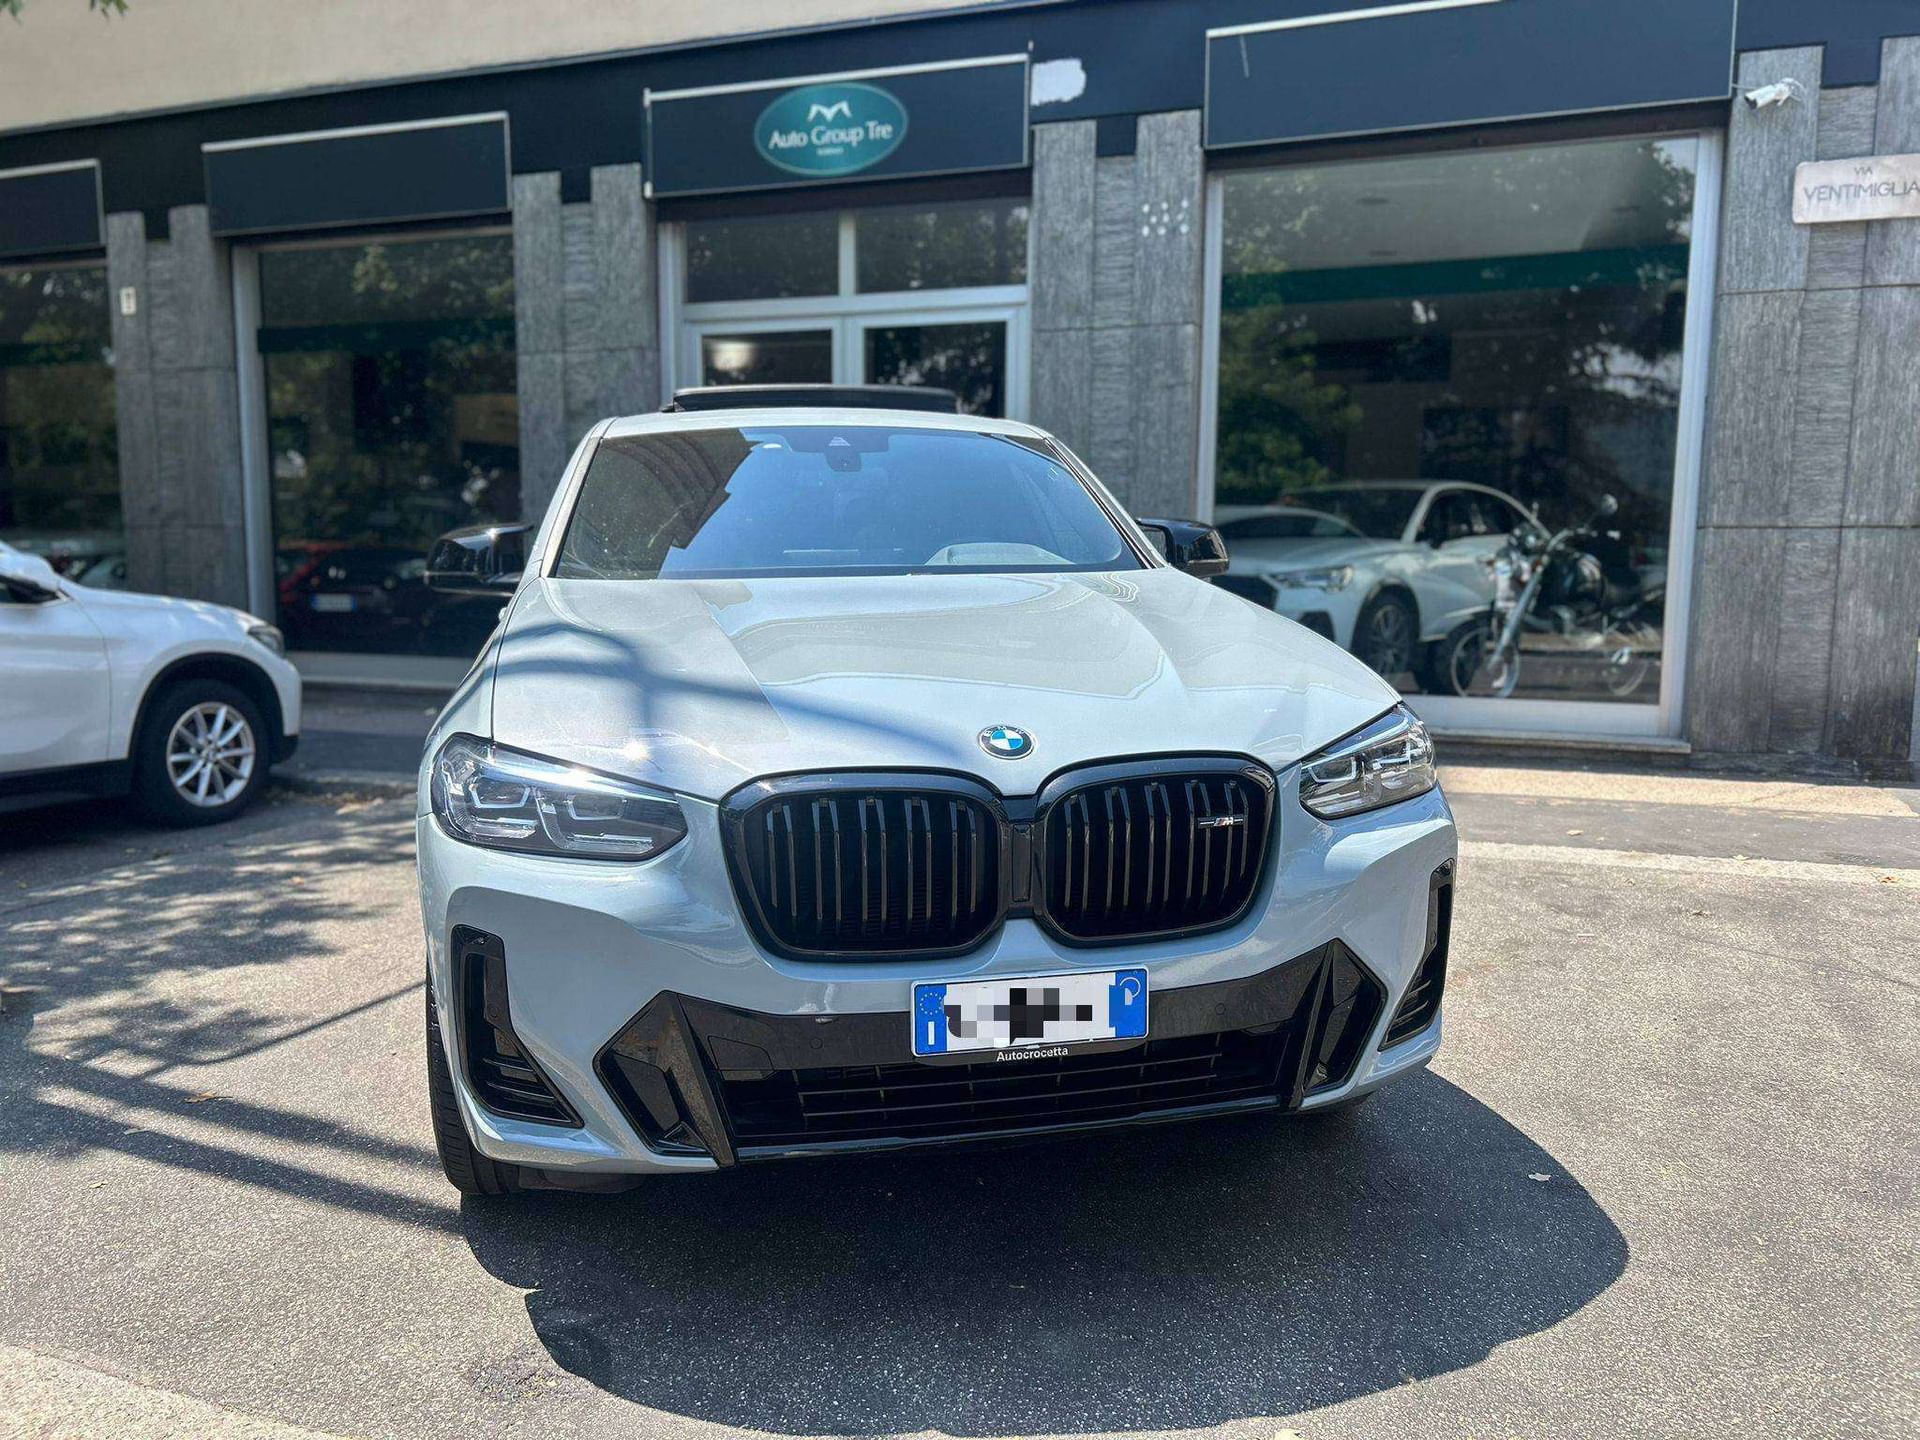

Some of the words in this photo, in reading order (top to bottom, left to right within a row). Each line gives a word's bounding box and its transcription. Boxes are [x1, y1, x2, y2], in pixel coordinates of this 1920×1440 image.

[768, 130, 808, 149] Auto
[811, 126, 864, 147] Group
[866, 120, 893, 140] Tre
[1854, 166, 1873, 176] VIA
[1803, 180, 1920, 202] VENTIMIGLIA
[996, 1046, 1069, 1063] Autocrocetta
